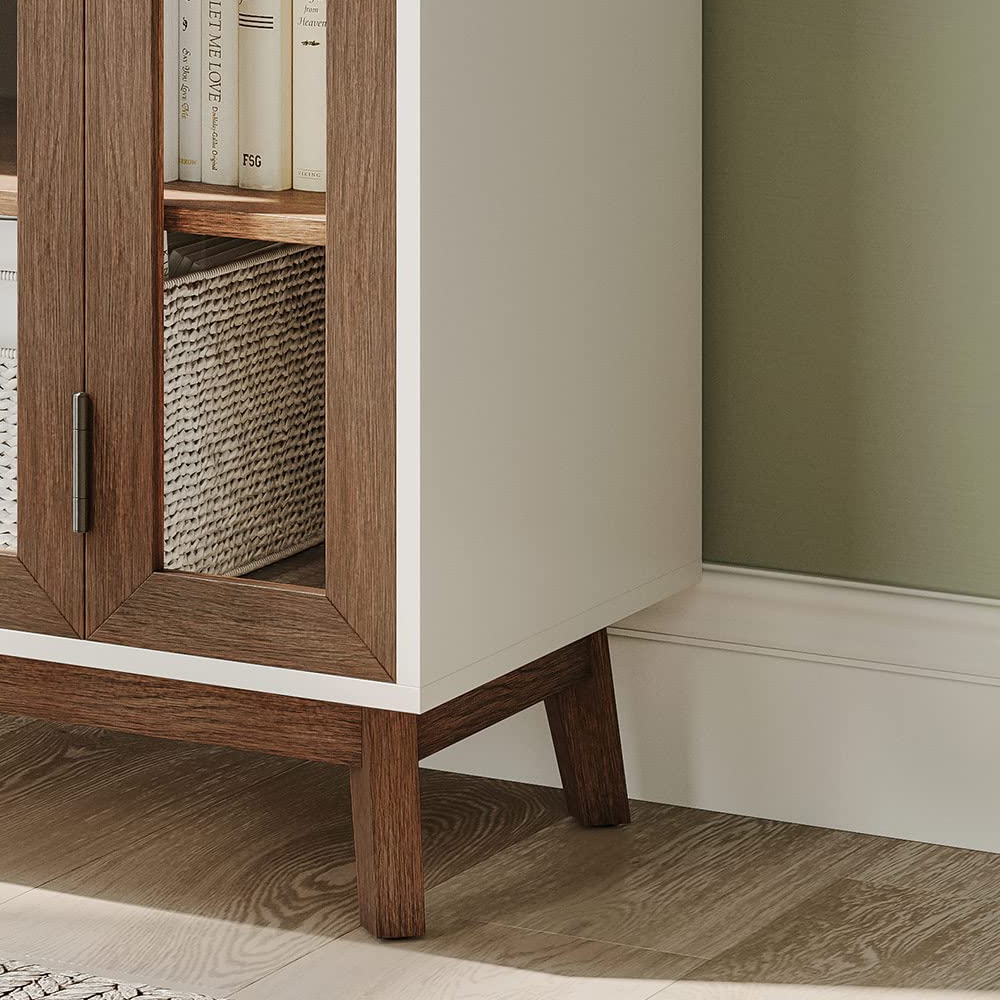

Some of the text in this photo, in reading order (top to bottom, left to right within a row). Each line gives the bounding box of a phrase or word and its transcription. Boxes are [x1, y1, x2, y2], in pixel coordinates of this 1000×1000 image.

[209, 1, 221, 31] LET
[303, 5, 319, 14] from
[297, 17, 327, 28] Heaven
[209, 33, 221, 58] ME
[209, 62, 222, 102] LOVE
[242, 153, 262, 168] FSG
